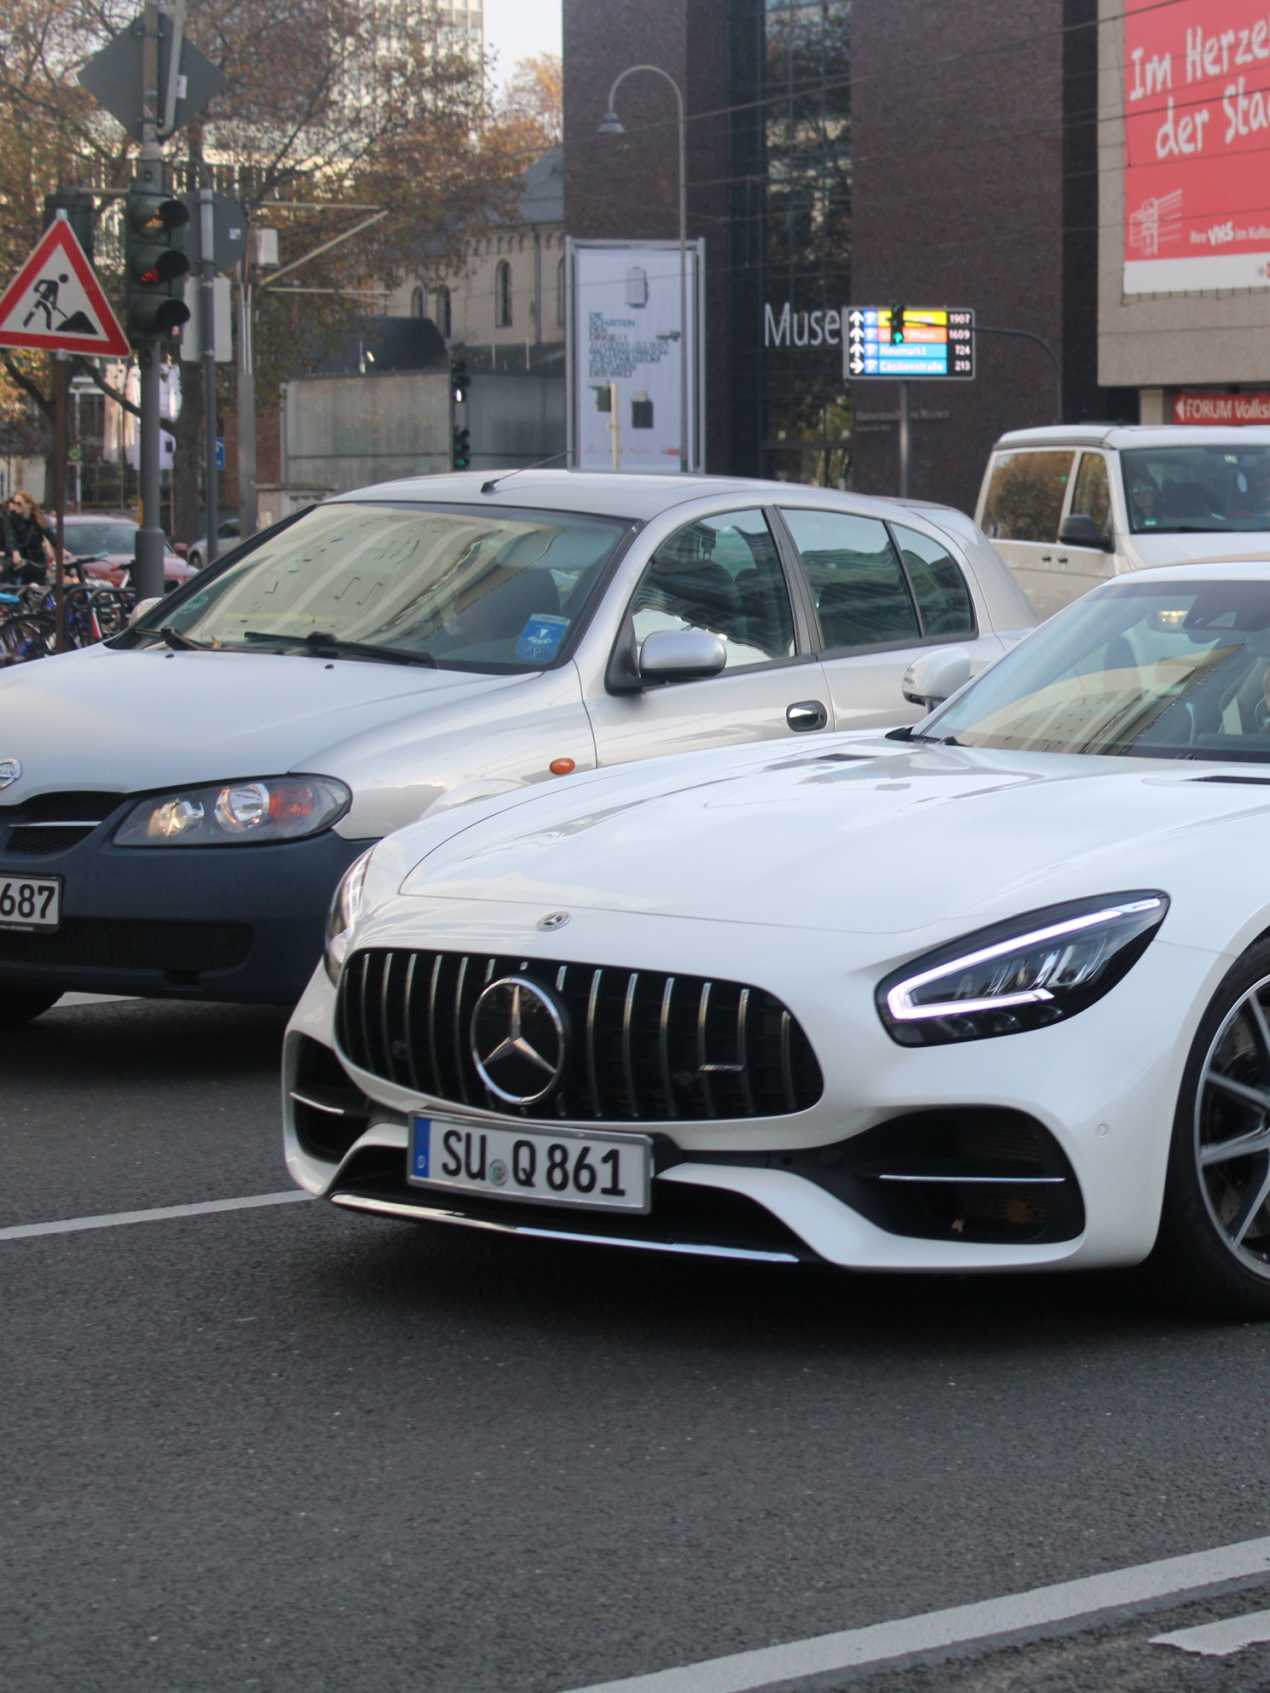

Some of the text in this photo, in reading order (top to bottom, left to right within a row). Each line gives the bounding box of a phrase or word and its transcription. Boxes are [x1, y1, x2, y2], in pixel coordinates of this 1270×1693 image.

[1130, 47, 1172, 101] Im
[1155, 96, 1210, 159] der
[1208, 221, 1235, 246] VHS
[880, 345, 927, 356] Neumarkt
[954, 344, 971, 356] 724
[954, 359, 971, 372] 213
[1186, 399, 1232, 419] FORUM
[0, 882, 56, 920] 687
[442, 1129, 487, 1181] SU
[512, 1139, 536, 1187] Q
[546, 1143, 626, 1197] 861
